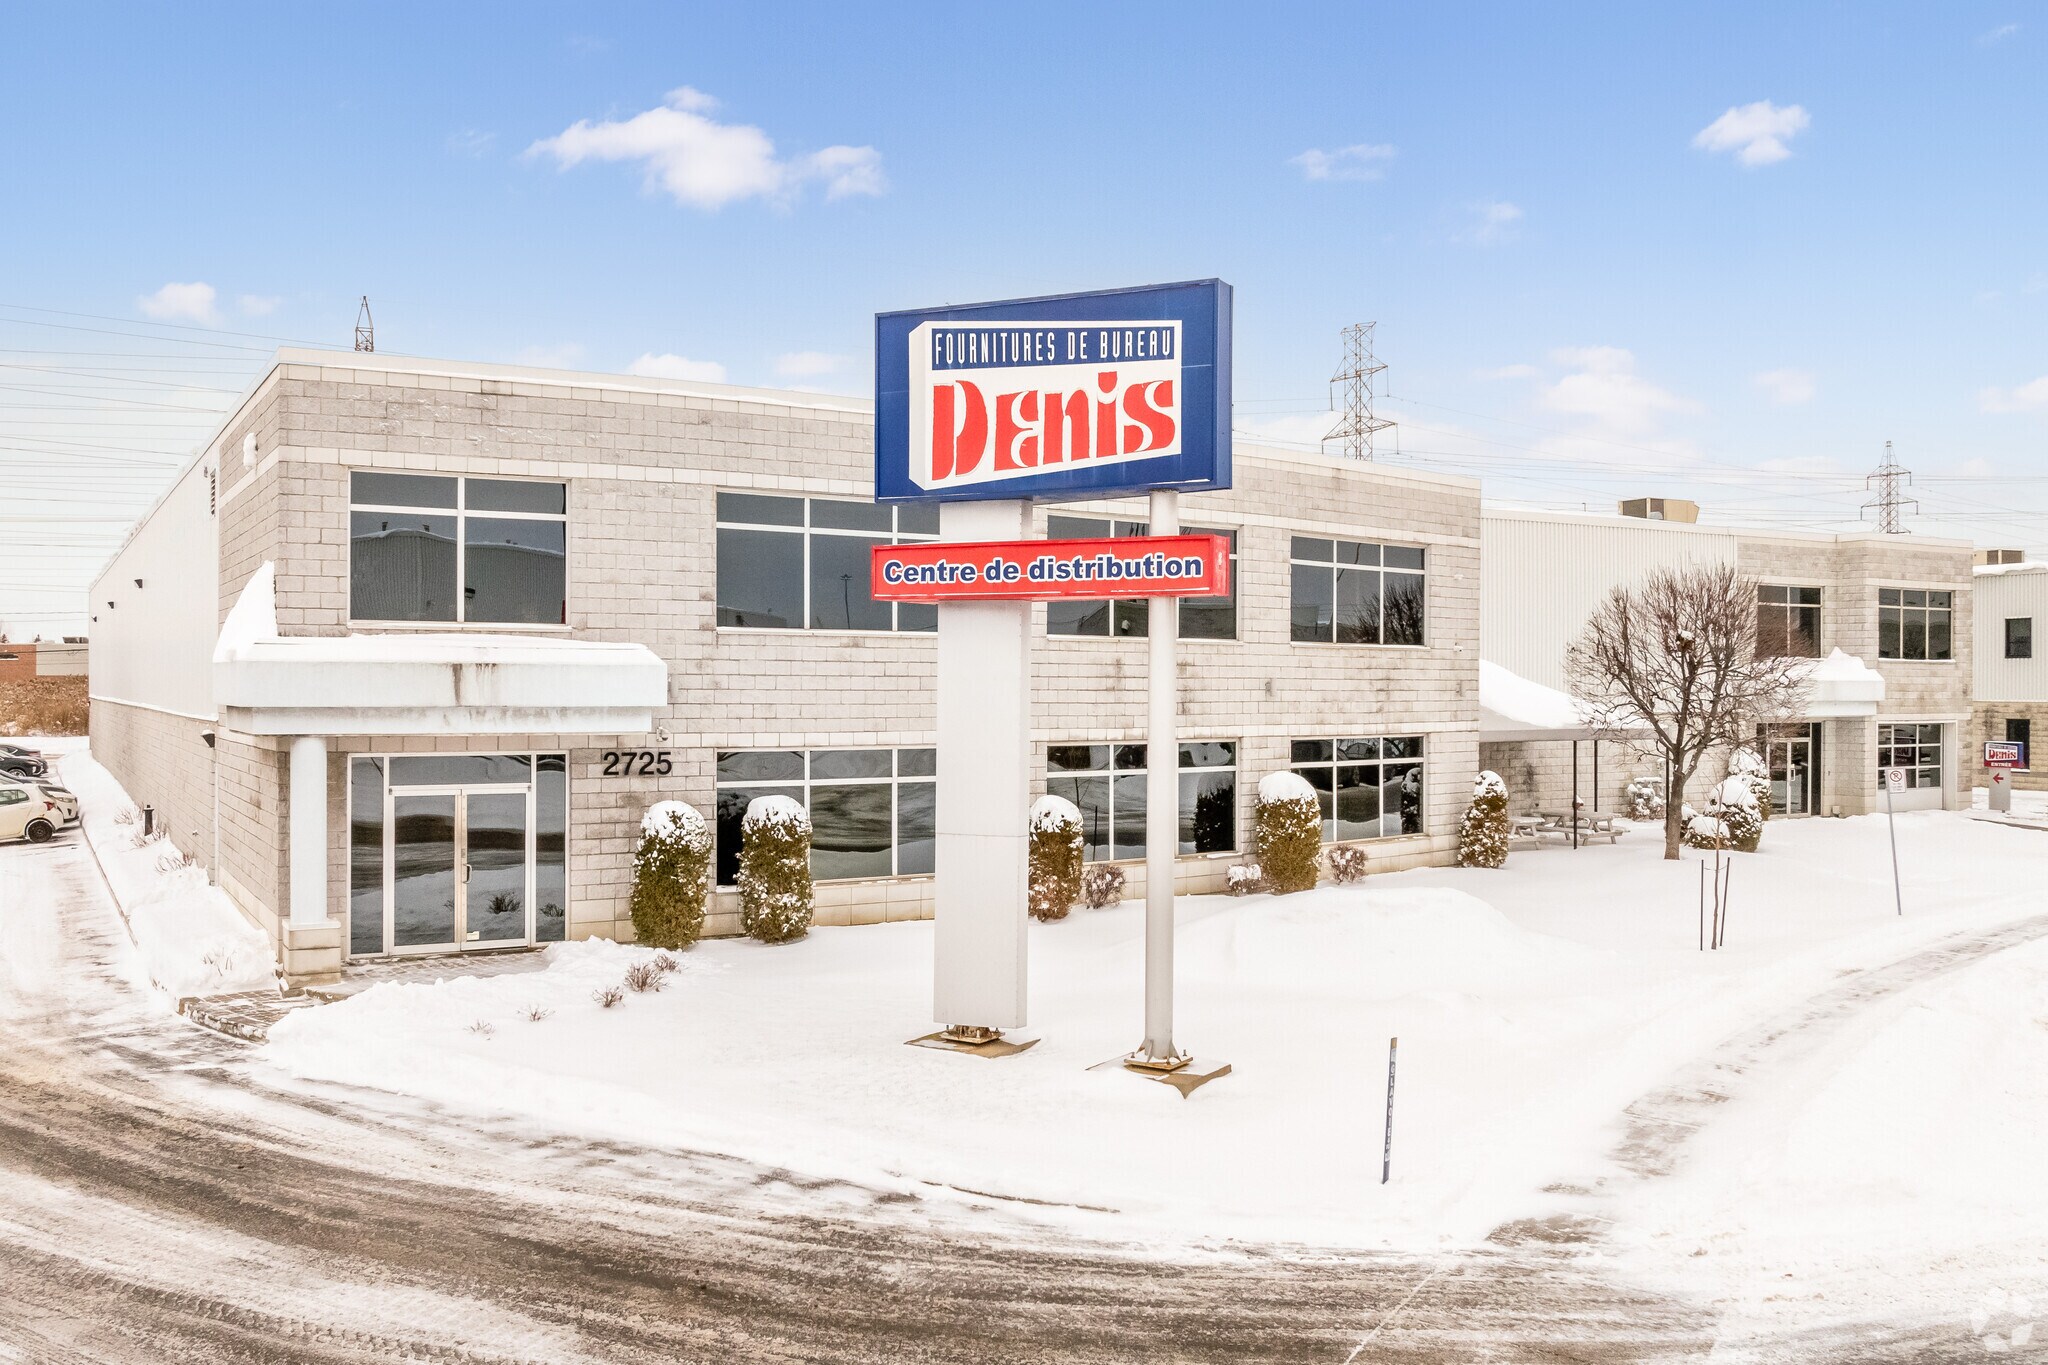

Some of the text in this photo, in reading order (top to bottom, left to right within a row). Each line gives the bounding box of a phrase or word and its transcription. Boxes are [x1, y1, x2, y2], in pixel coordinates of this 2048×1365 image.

[935, 329, 1171, 365] FOURNITURES DE BUREAU
[883, 553, 1204, 585] Centre de distribution
[602, 751, 673, 776] 2725
